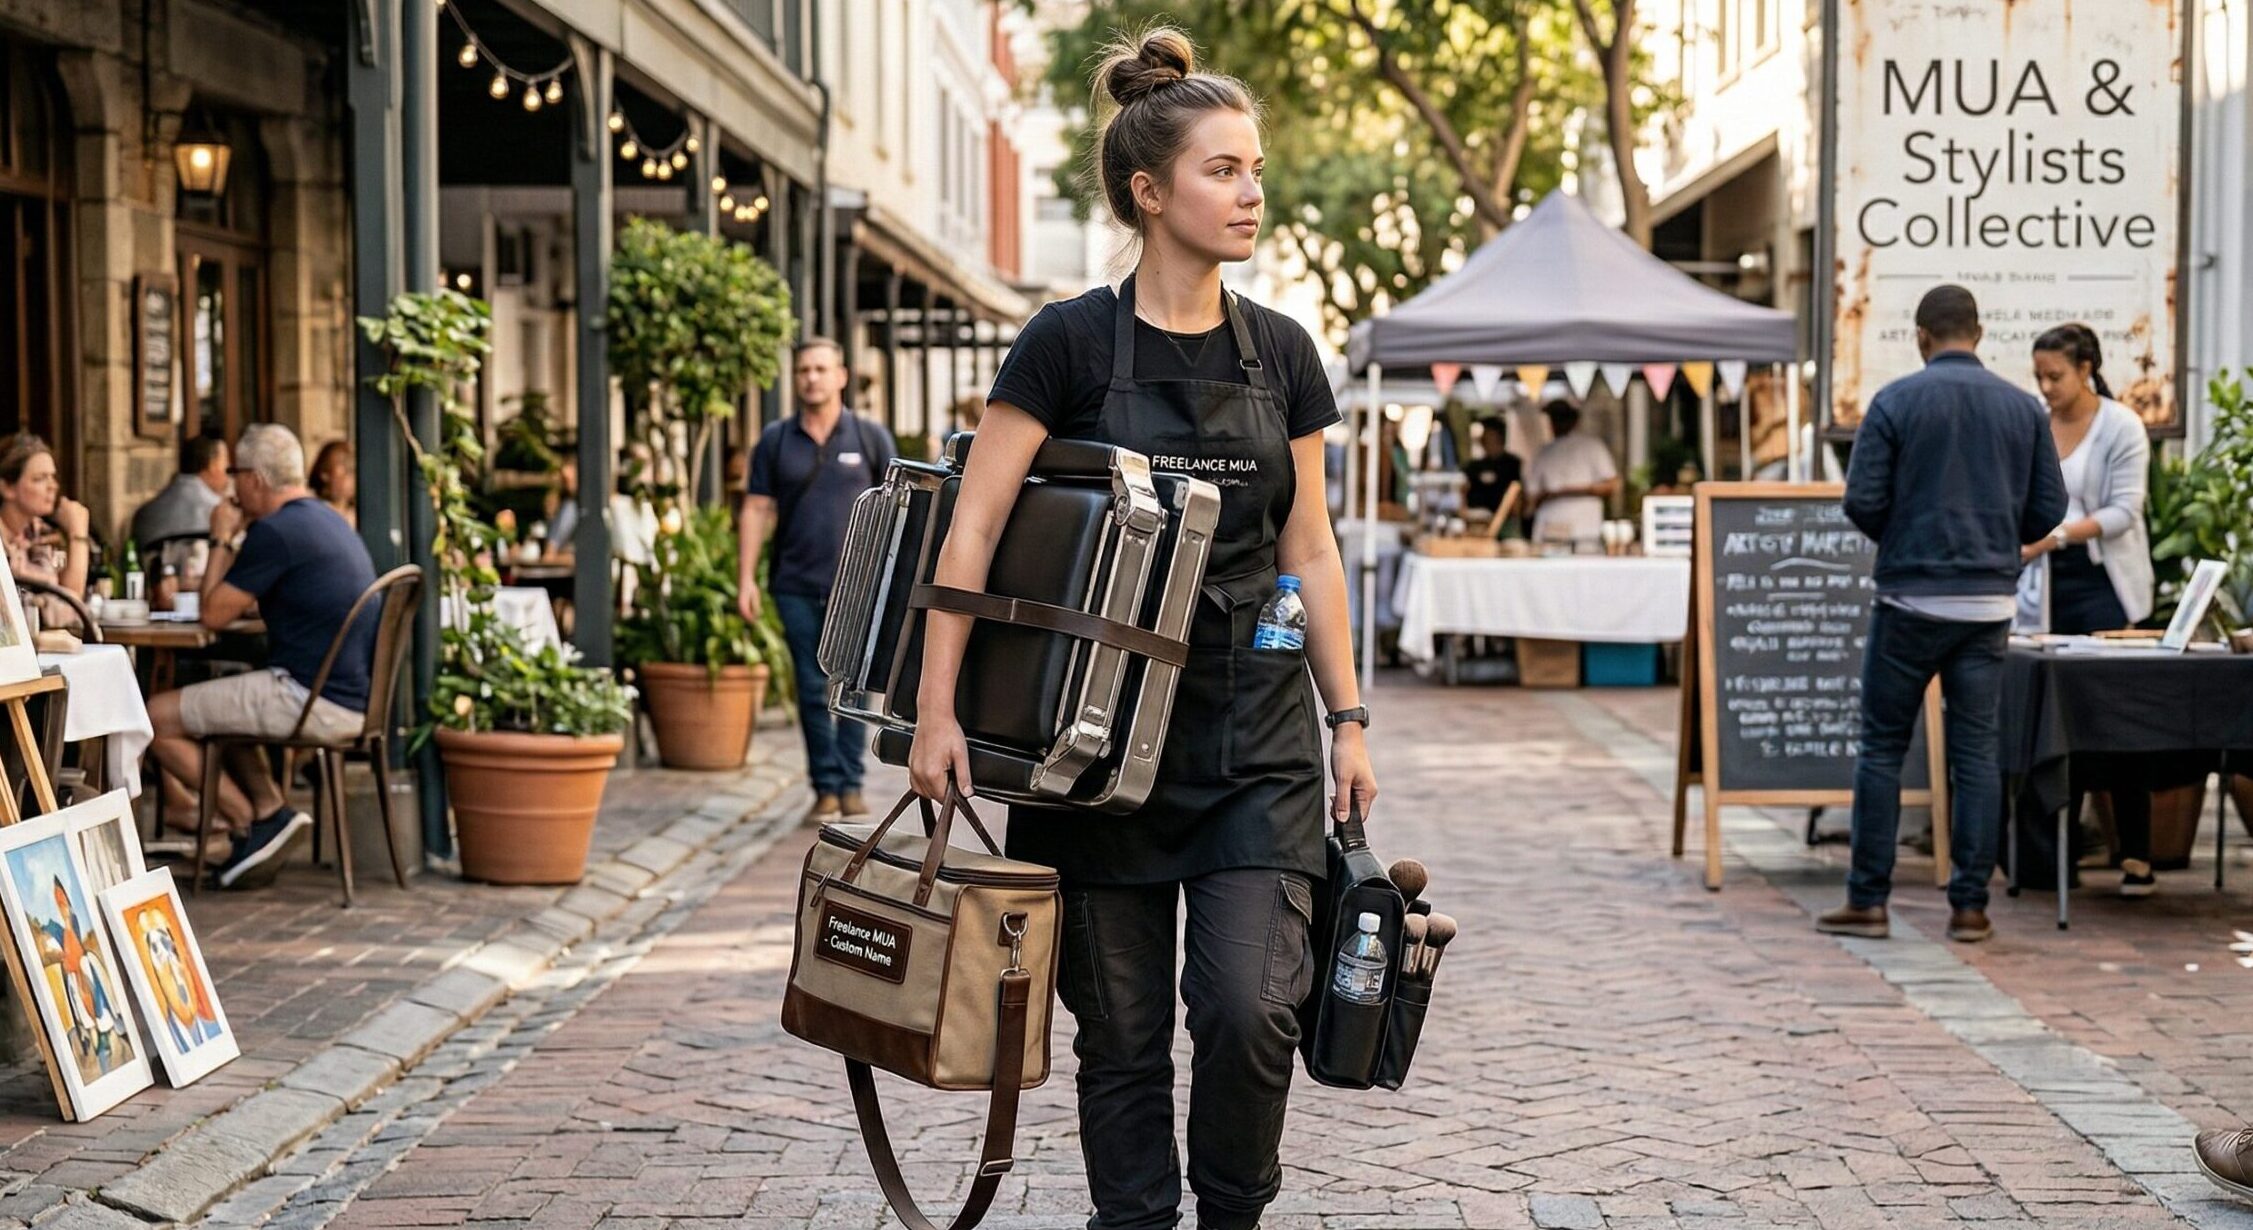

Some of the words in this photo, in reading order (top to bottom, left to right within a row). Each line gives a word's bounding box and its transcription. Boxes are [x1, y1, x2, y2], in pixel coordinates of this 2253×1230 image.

[1883, 59, 2058, 116] MUA
[2085, 59, 2135, 116] &
[1903, 129, 2125, 199] Stylists
[1858, 197, 2155, 248] Collective
[1152, 455, 1226, 471] FREELANCE
[1229, 459, 1258, 472] MUA
[828, 915, 871, 941] Freelance
[872, 929, 896, 949] MUA
[830, 935, 863, 957] Custom
[864, 945, 892, 967] Name
